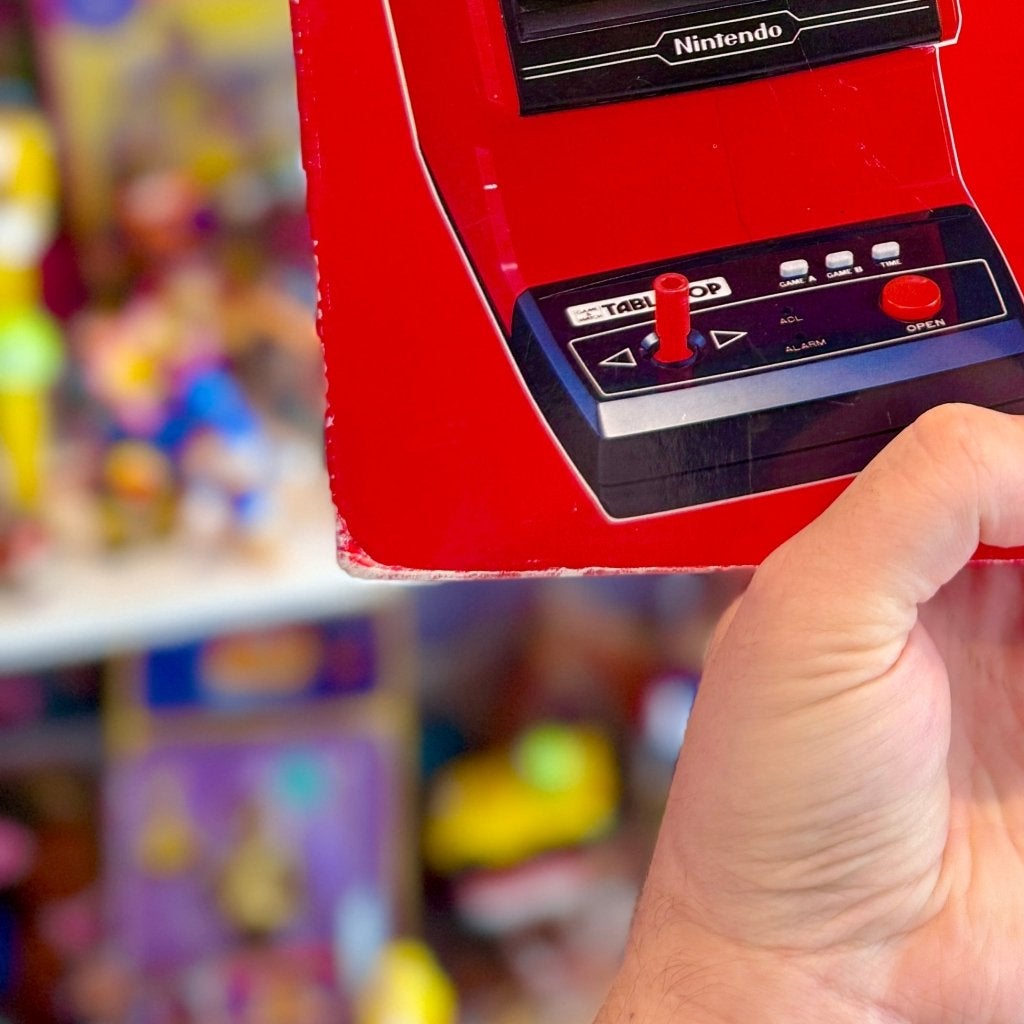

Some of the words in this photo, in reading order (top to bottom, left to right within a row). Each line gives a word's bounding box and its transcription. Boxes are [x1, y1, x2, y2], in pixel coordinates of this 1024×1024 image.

[674, 23, 782, 55] Nintendo
[602, 296, 655, 315] TABL
[689, 282, 721, 298] OP
[780, 315, 803, 324] ACL
[906, 318, 946, 332] OPEN
[785, 338, 827, 352] ALARM
